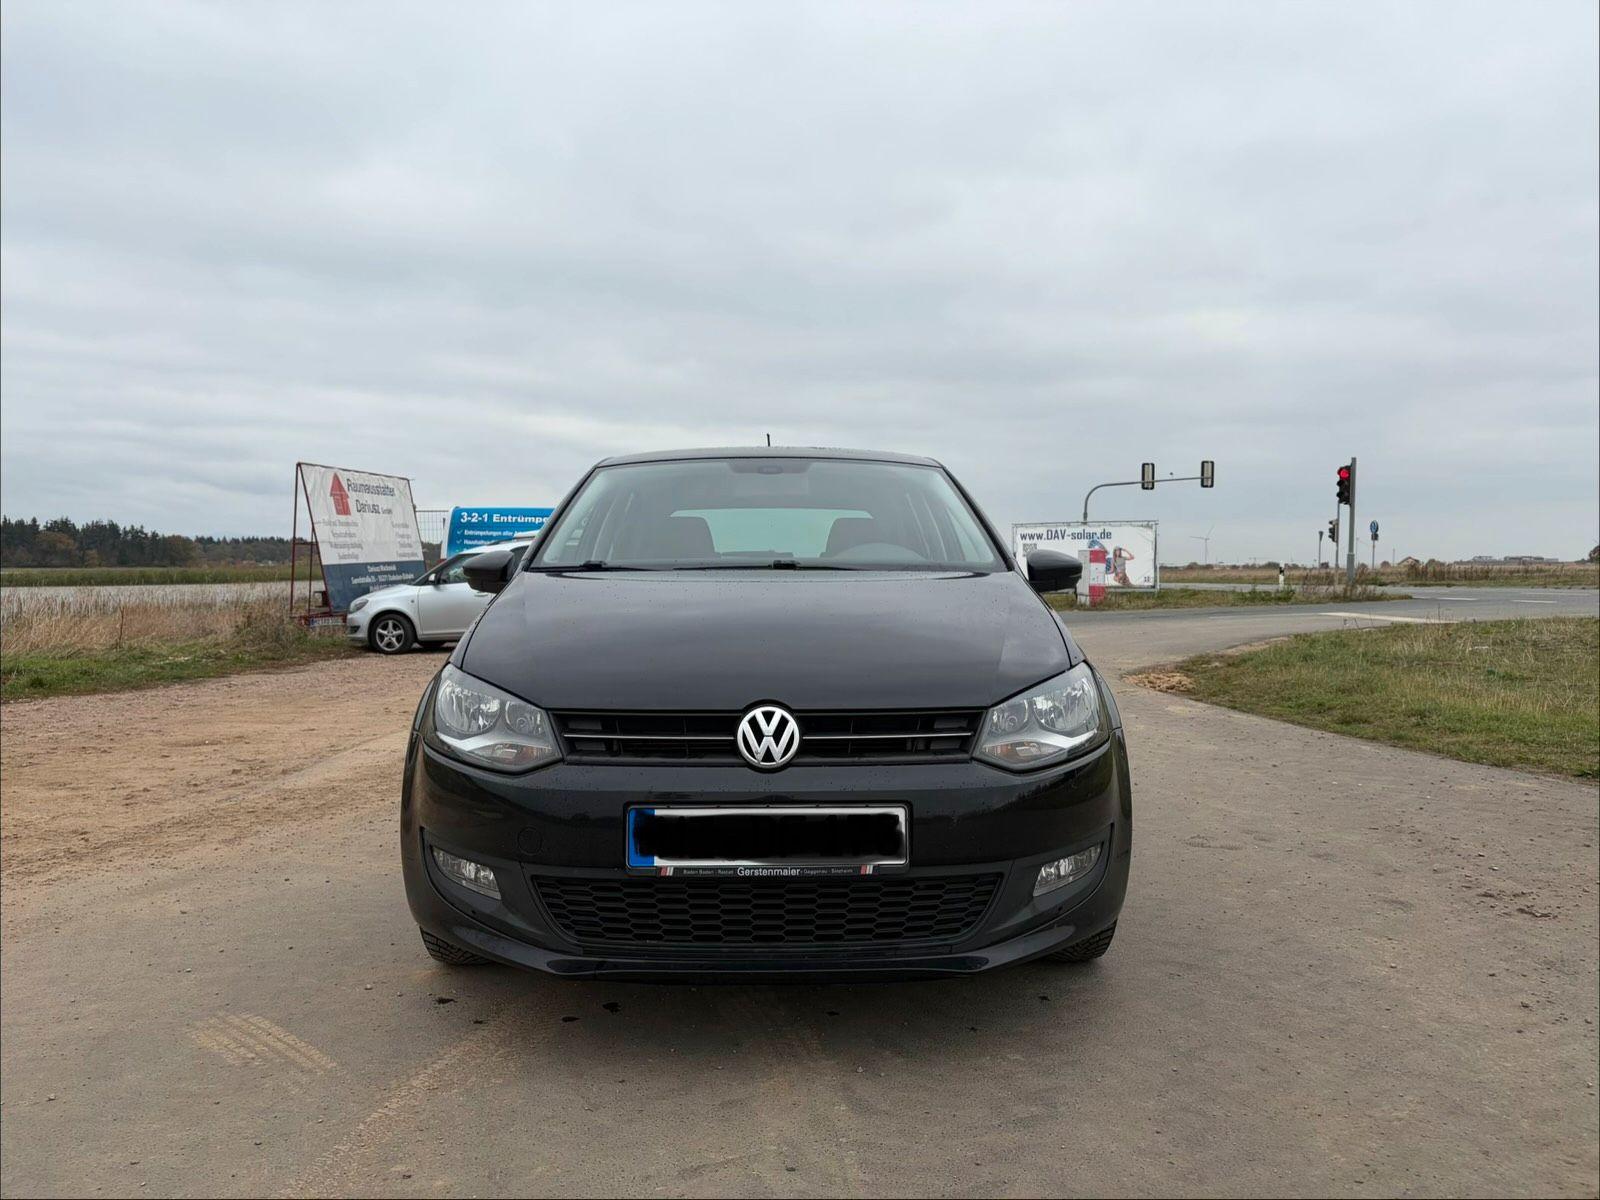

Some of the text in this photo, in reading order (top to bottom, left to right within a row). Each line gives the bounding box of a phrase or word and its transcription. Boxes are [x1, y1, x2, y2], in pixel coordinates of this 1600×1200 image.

[461, 512, 488, 523] 3-2-1
[1020, 529, 1112, 541] www.DAV-solar.de
[737, 866, 800, 876] Gerstenmaier
